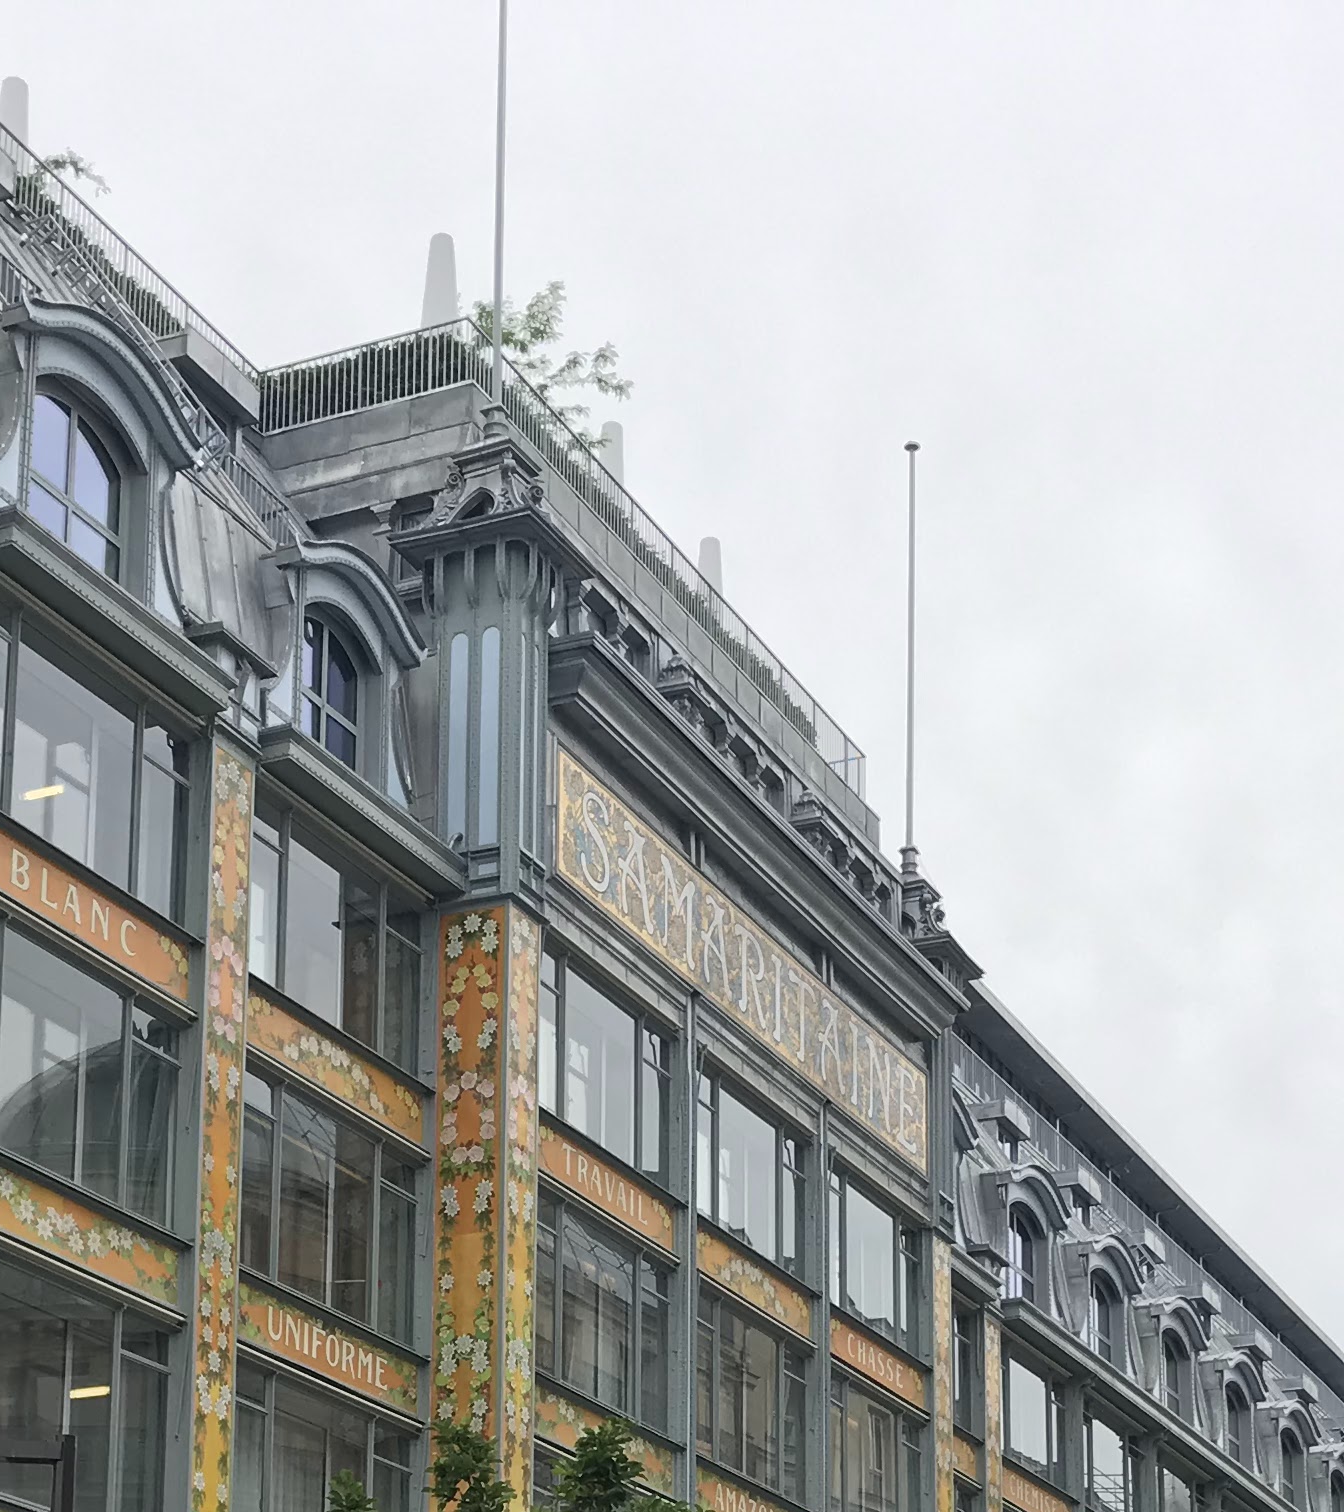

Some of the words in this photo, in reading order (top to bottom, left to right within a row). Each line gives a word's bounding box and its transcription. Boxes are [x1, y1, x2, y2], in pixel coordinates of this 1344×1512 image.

[10, 847, 137, 957] BLANC
[579, 791, 918, 1154] SAMARITAINE
[561, 1142, 648, 1226] TRAVAIL
[267, 1304, 388, 1391] UNIFORME
[847, 1332, 904, 1389] CHASSE
